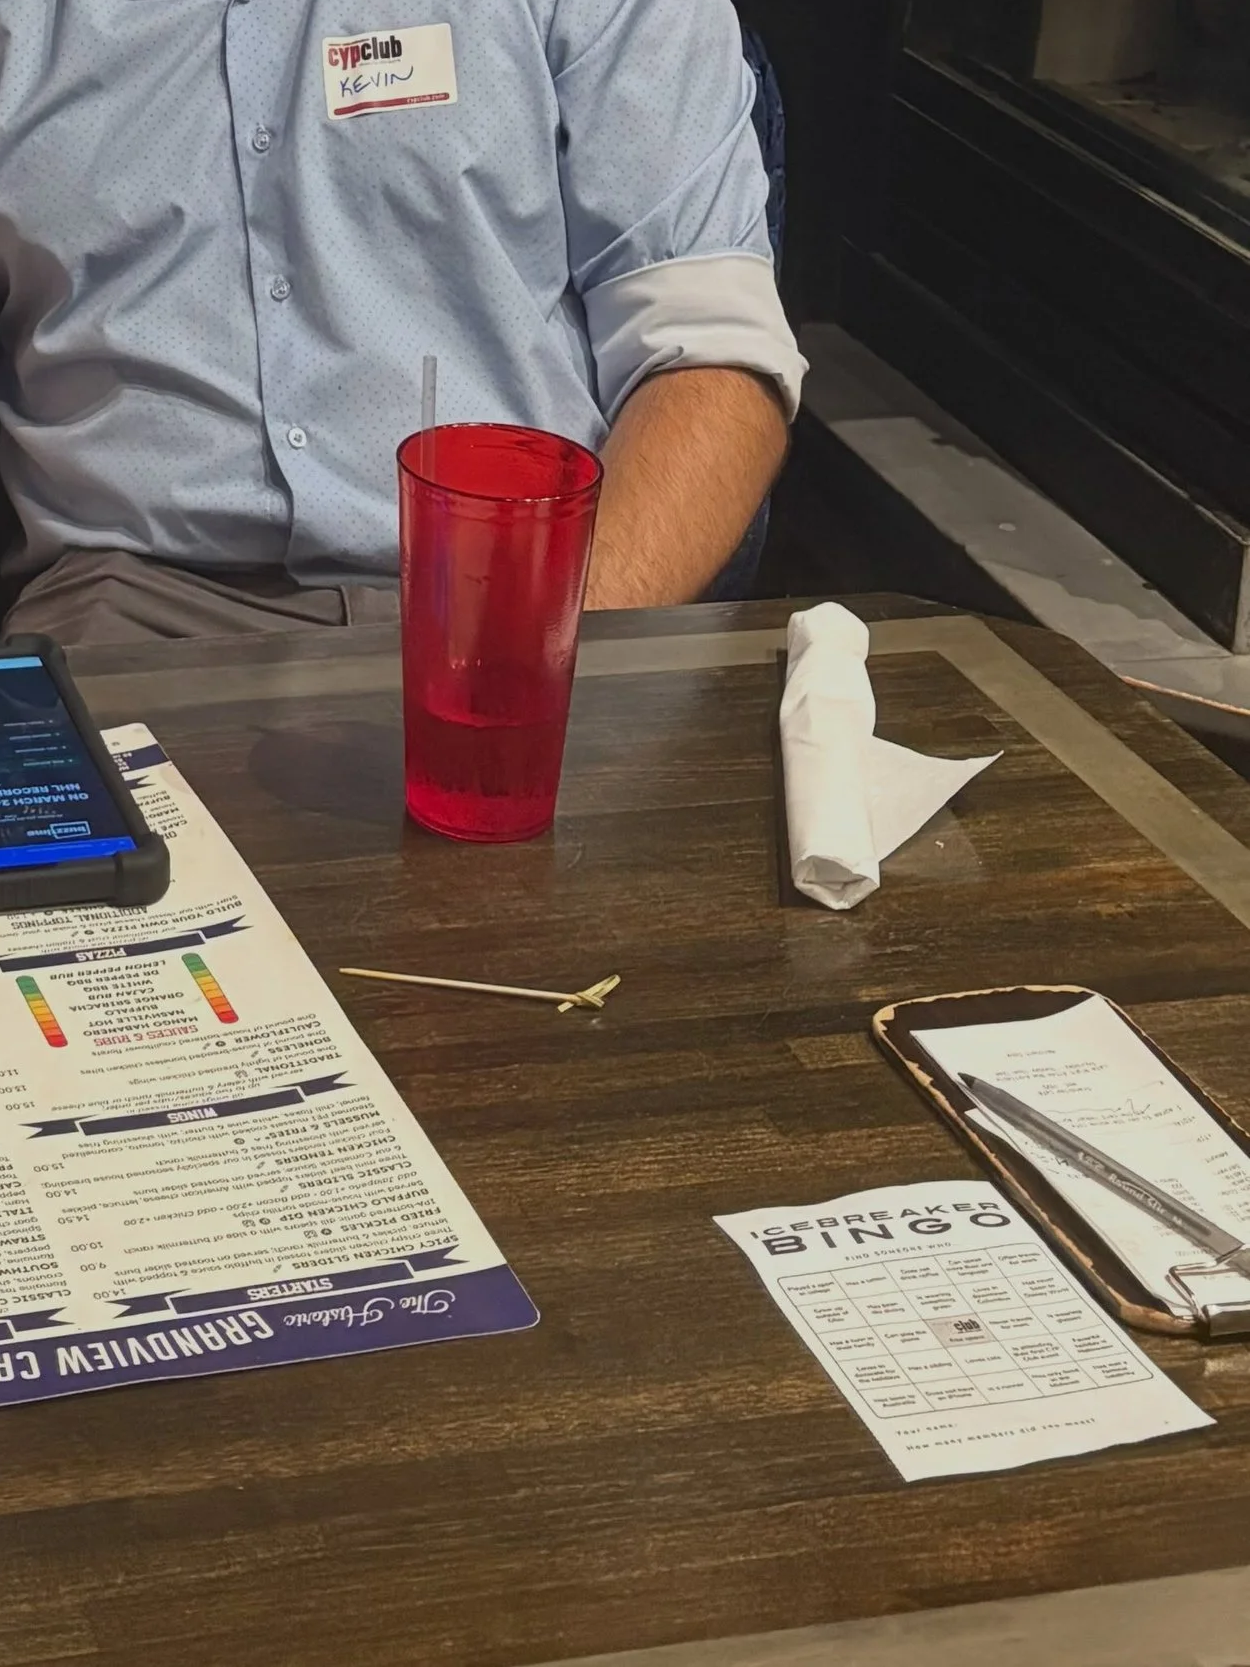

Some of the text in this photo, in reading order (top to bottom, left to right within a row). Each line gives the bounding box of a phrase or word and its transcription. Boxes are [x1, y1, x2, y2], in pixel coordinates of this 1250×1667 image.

[327, 35, 403, 71] cypclub
[339, 65, 414, 98] KEVIN
[12, 793, 66, 806] MARCH
[50, 782, 81, 793] NHL
[68, 792, 89, 801] ON
[75, 947, 128, 963] PIZZAS
[50, 959, 166, 981] LEMON PEPPER RUB
[87, 992, 112, 1001] RUB
[82, 1015, 199, 1038] MANGO HABANERO
[145, 1024, 199, 1041] SAUCES
[93, 1034, 132, 1047] RUBS
[254, 1050, 344, 1075] TRADITIONAL
[166, 1106, 218, 1124] WINGS
[749, 1201, 1002, 1239] ICEBREAKER
[79, 1206, 442, 1273] FRIED PICKLES 9.00
[760, 1211, 1012, 1256] BINGO
[92, 1233, 459, 1301] SPICY CHICKEN SLIDERS 14.00
[247, 1275, 333, 1301] STARTERS
[283, 1296, 396, 1329] Historic
[399, 1289, 456, 1315] The
[55, 1308, 276, 1378] GRANDVIEW
